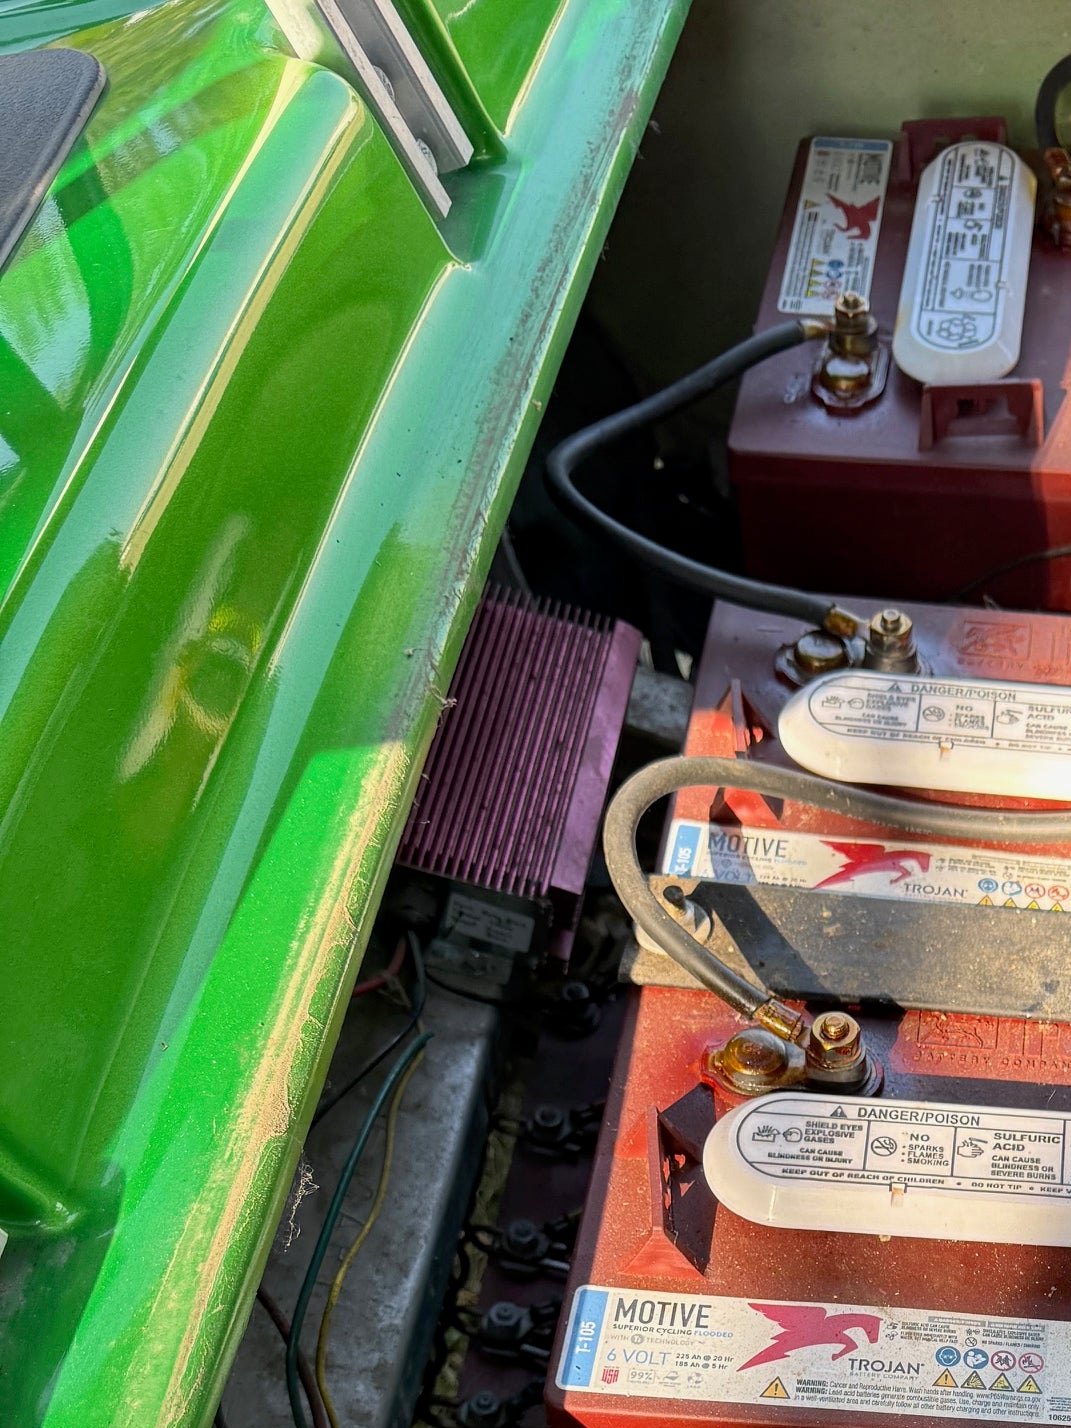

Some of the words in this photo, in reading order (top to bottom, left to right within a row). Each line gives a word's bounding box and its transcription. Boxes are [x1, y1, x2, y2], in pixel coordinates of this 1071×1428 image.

[708, 833, 789, 858] MOTIVE
[903, 883, 967, 899] TROJAN
[856, 1106, 980, 1126] DANGER/POISON
[909, 1132, 930, 1142] NO
[993, 1131, 1060, 1144] SULFURIC
[907, 1143, 944, 1153] SPARKS
[991, 1141, 1025, 1152] ACID
[906, 1156, 949, 1166] SMOKING
[613, 1297, 712, 1329] MOTIVE
[575, 1320, 596, 1354] T-105
[612, 1323, 654, 1332] SUPERIOR
[656, 1327, 692, 1335] CYCLING
[693, 1329, 733, 1338] FLOODED
[606, 1348, 617, 1361] 6
[620, 1348, 671, 1366] VOLT
[601, 1367, 619, 1384] USA
[629, 1370, 653, 1380] 99%
[796, 1378, 828, 1386] WARNING:
